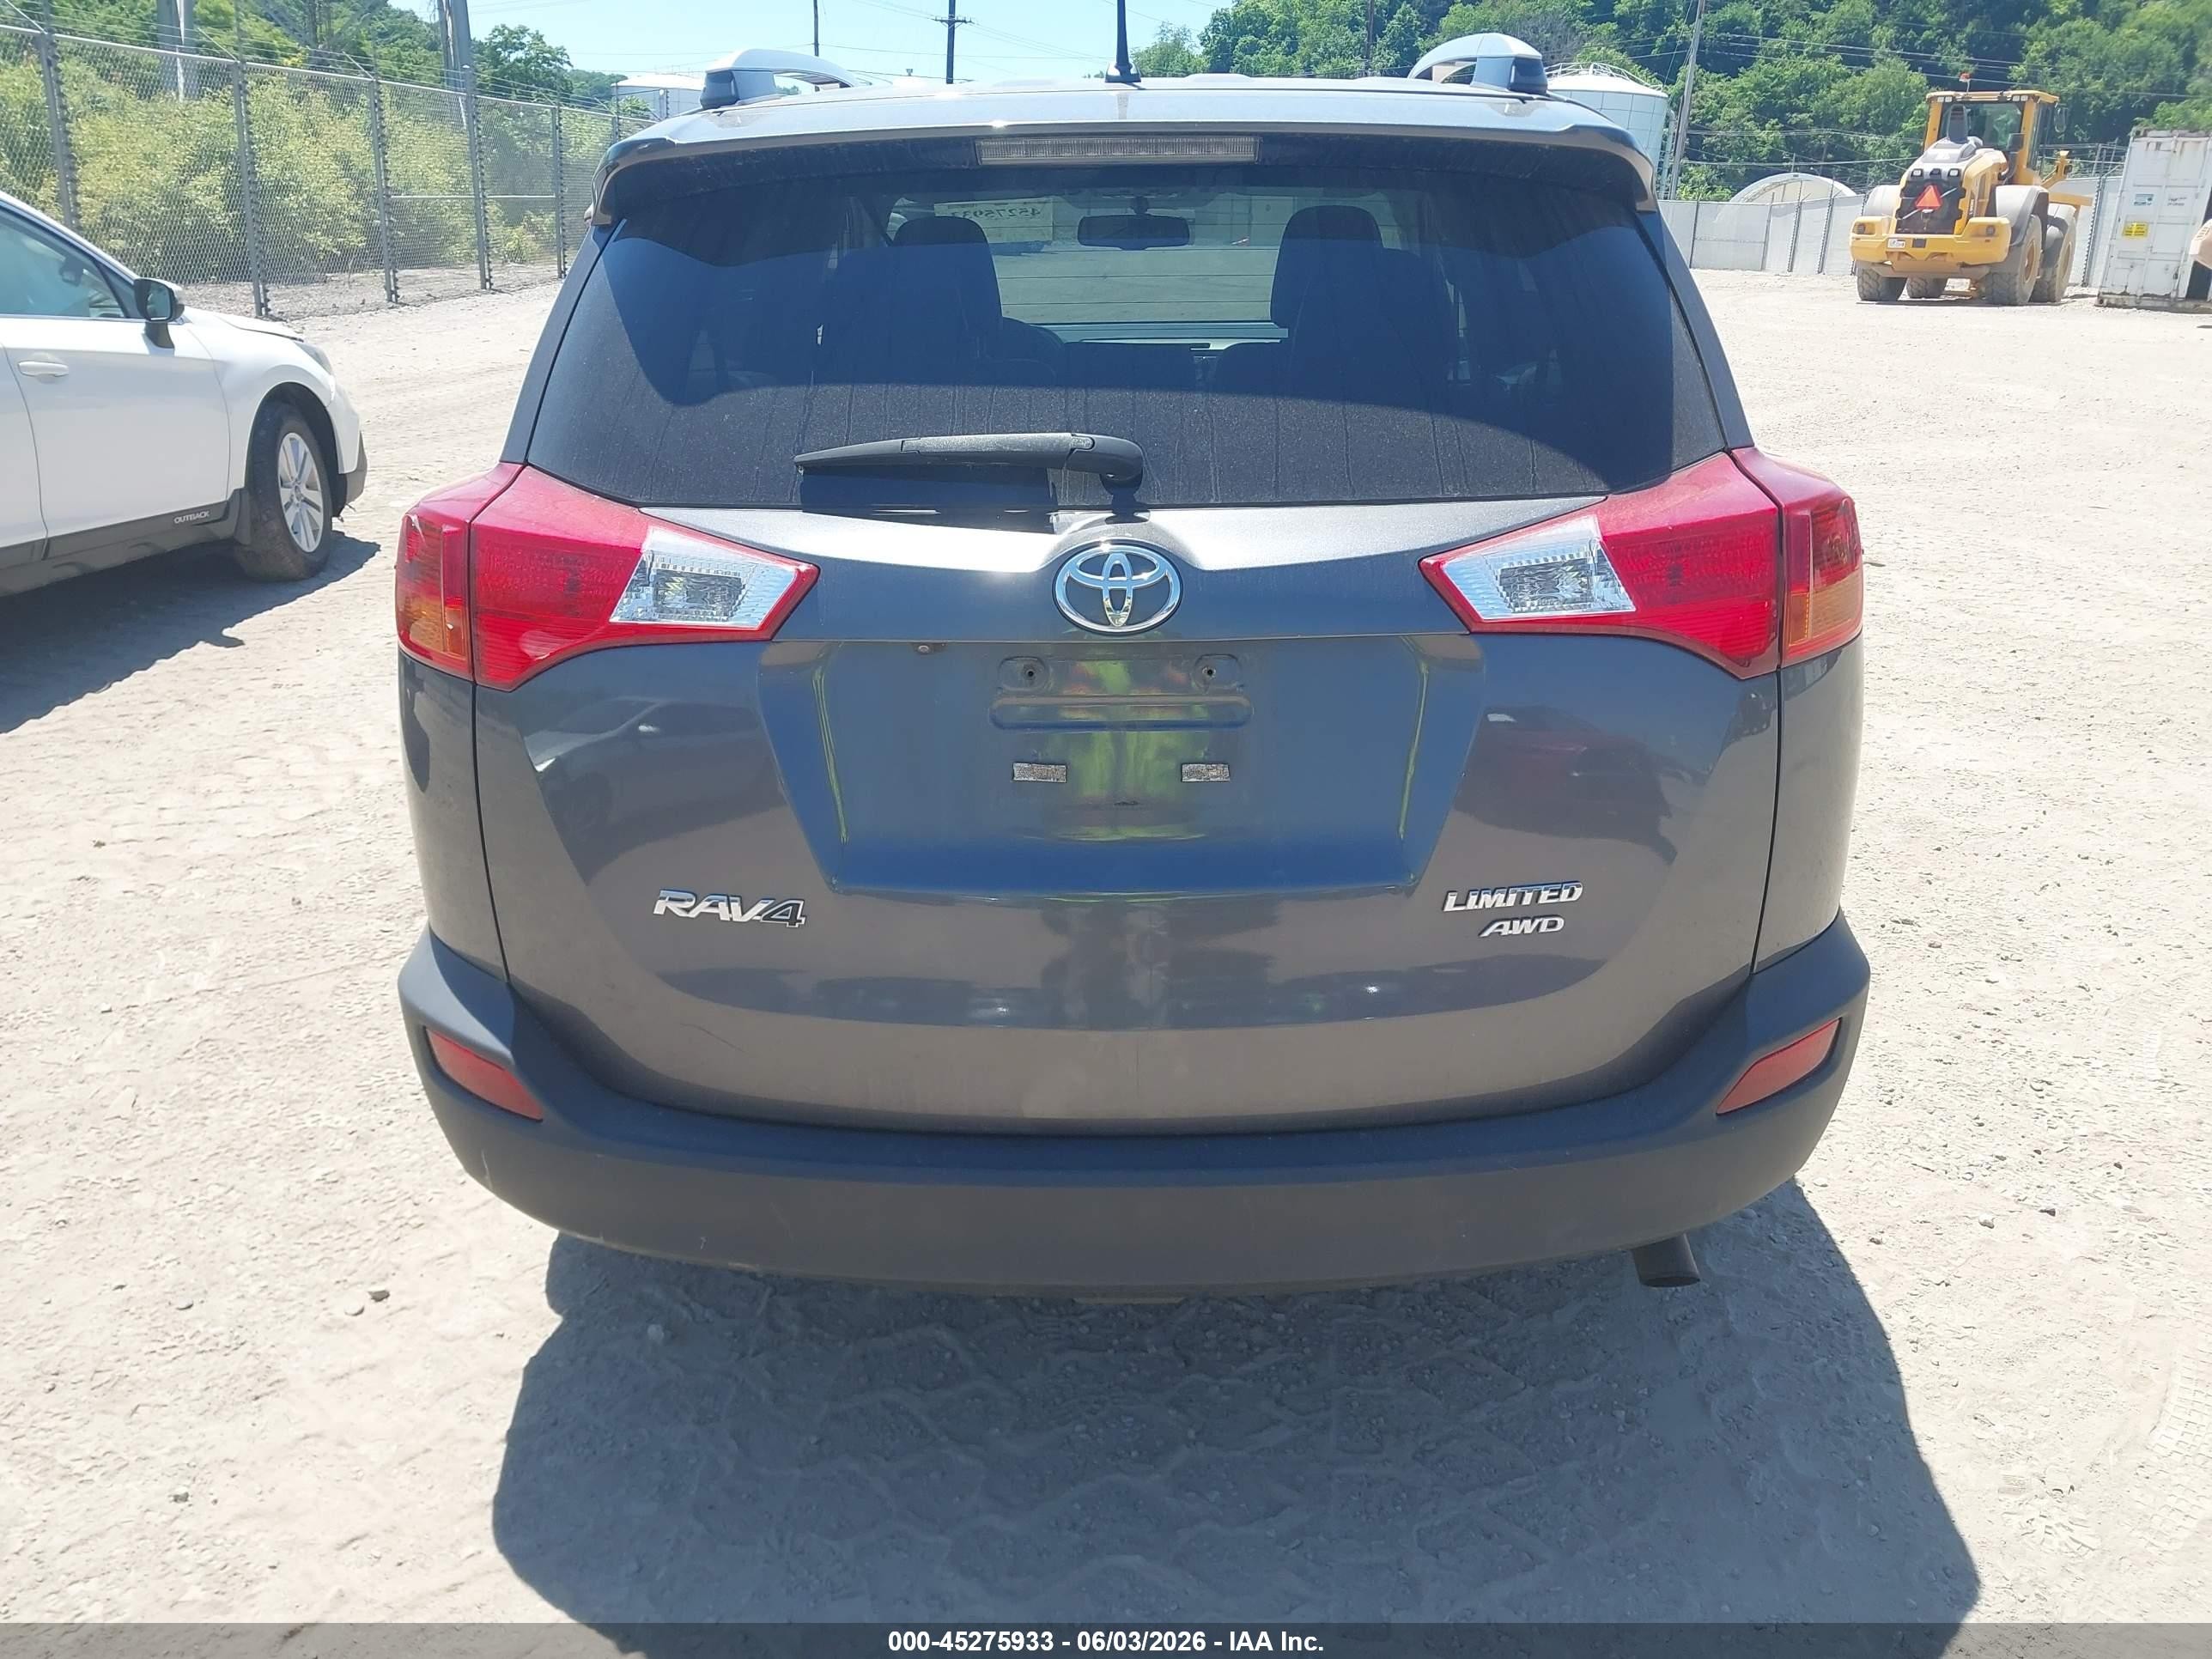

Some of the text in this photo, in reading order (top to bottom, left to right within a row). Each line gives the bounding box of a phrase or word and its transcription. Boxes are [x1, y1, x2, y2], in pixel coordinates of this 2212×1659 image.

[653, 889, 807, 928] RAV4
[1442, 880, 1584, 913] LIMITED
[1478, 915, 1565, 938] AWD
